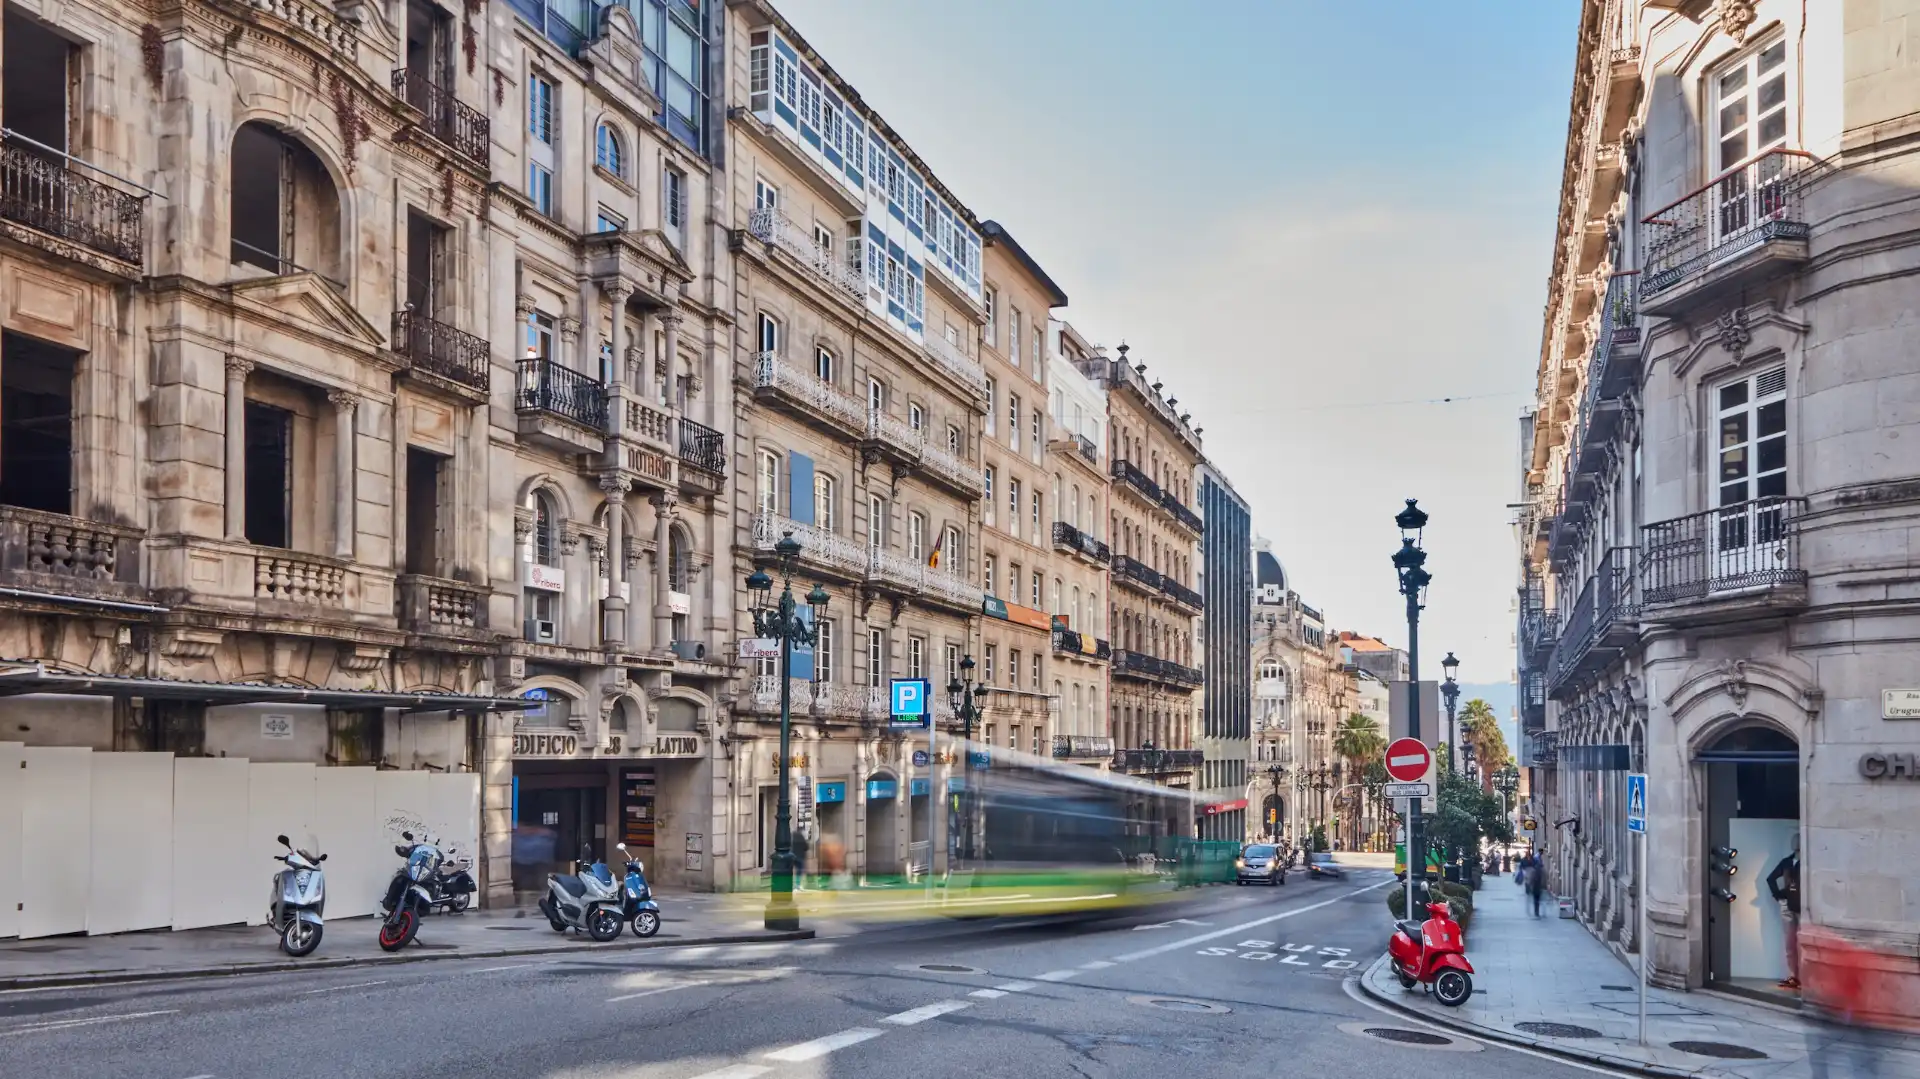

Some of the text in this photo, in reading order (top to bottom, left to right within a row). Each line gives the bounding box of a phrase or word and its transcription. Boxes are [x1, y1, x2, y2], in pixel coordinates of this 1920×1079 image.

[753, 648, 779, 657] ribera
[898, 685, 917, 711] P
[512, 734, 577, 755] EDIFICIO
[650, 736, 698, 755] LATINO
[1858, 752, 1920, 779] CH
[1195, 946, 1361, 969] SOLO
[1236, 939, 1352, 957] BUS
